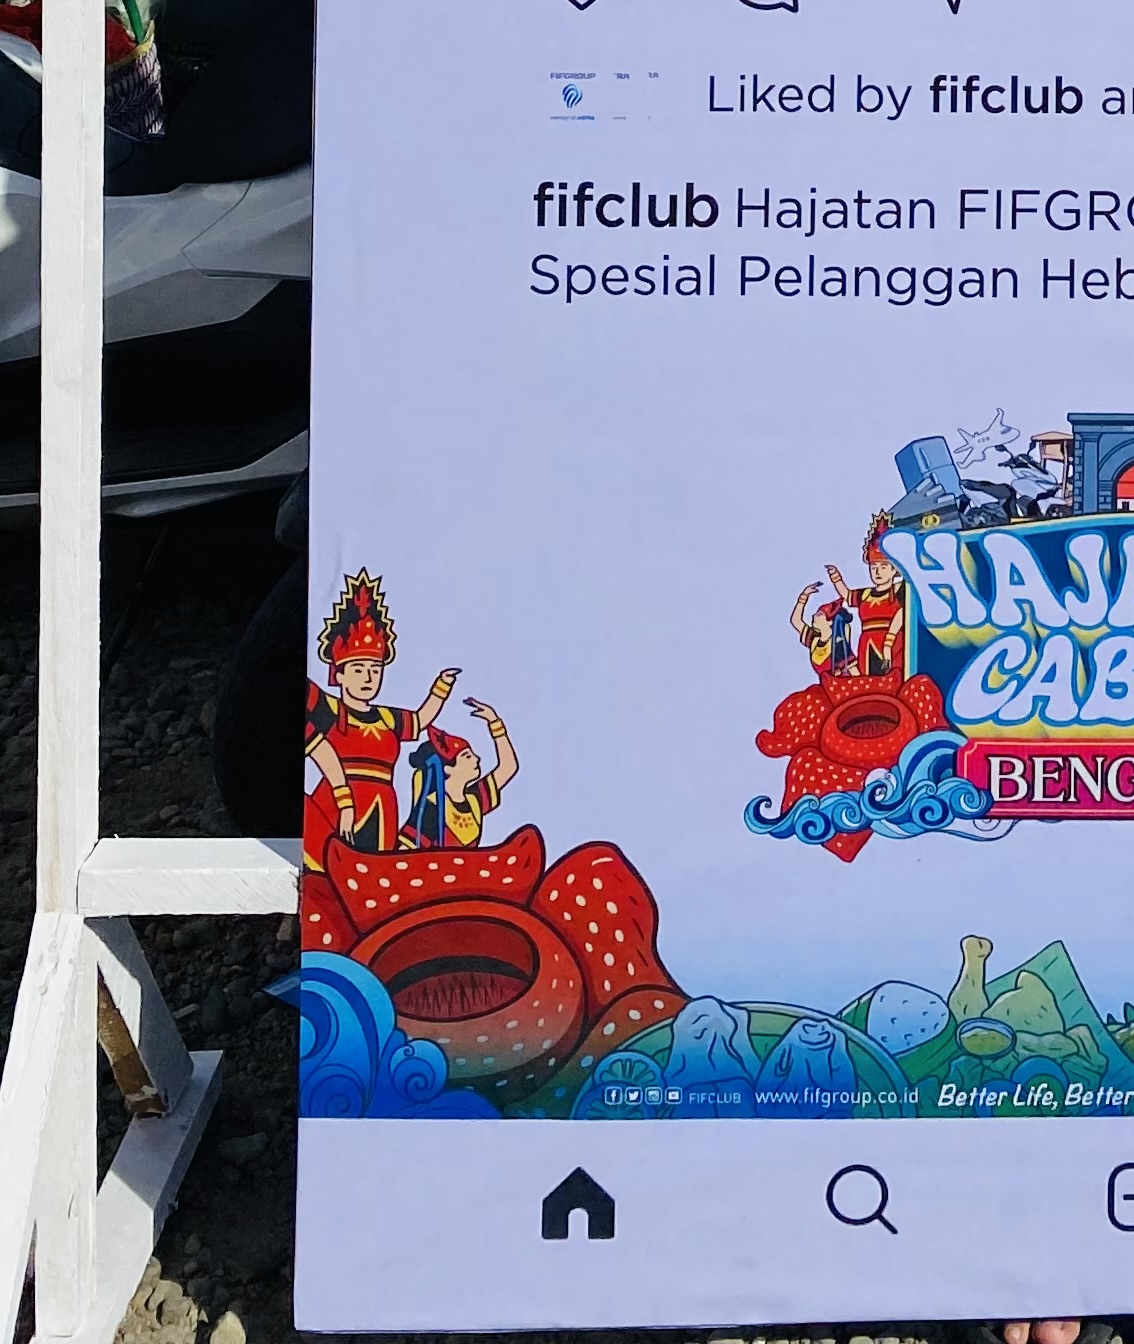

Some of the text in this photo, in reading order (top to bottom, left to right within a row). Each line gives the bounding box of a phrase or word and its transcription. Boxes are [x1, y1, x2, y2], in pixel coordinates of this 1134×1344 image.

[708, 74, 835, 113] Liked
[855, 74, 913, 122] by
[930, 74, 1083, 116] fifclub
[532, 182, 720, 229] fifclub
[737, 187, 937, 238] Hajatan
[529, 254, 717, 304] Spesial
[739, 255, 1020, 308] Pelanggan
[688, 1091, 742, 1105] FIFCLUB
[754, 1087, 920, 1109] www.fifgroup.co.id
[938, 1083, 1008, 1108] Better
[1013, 1083, 1060, 1111] Life,
